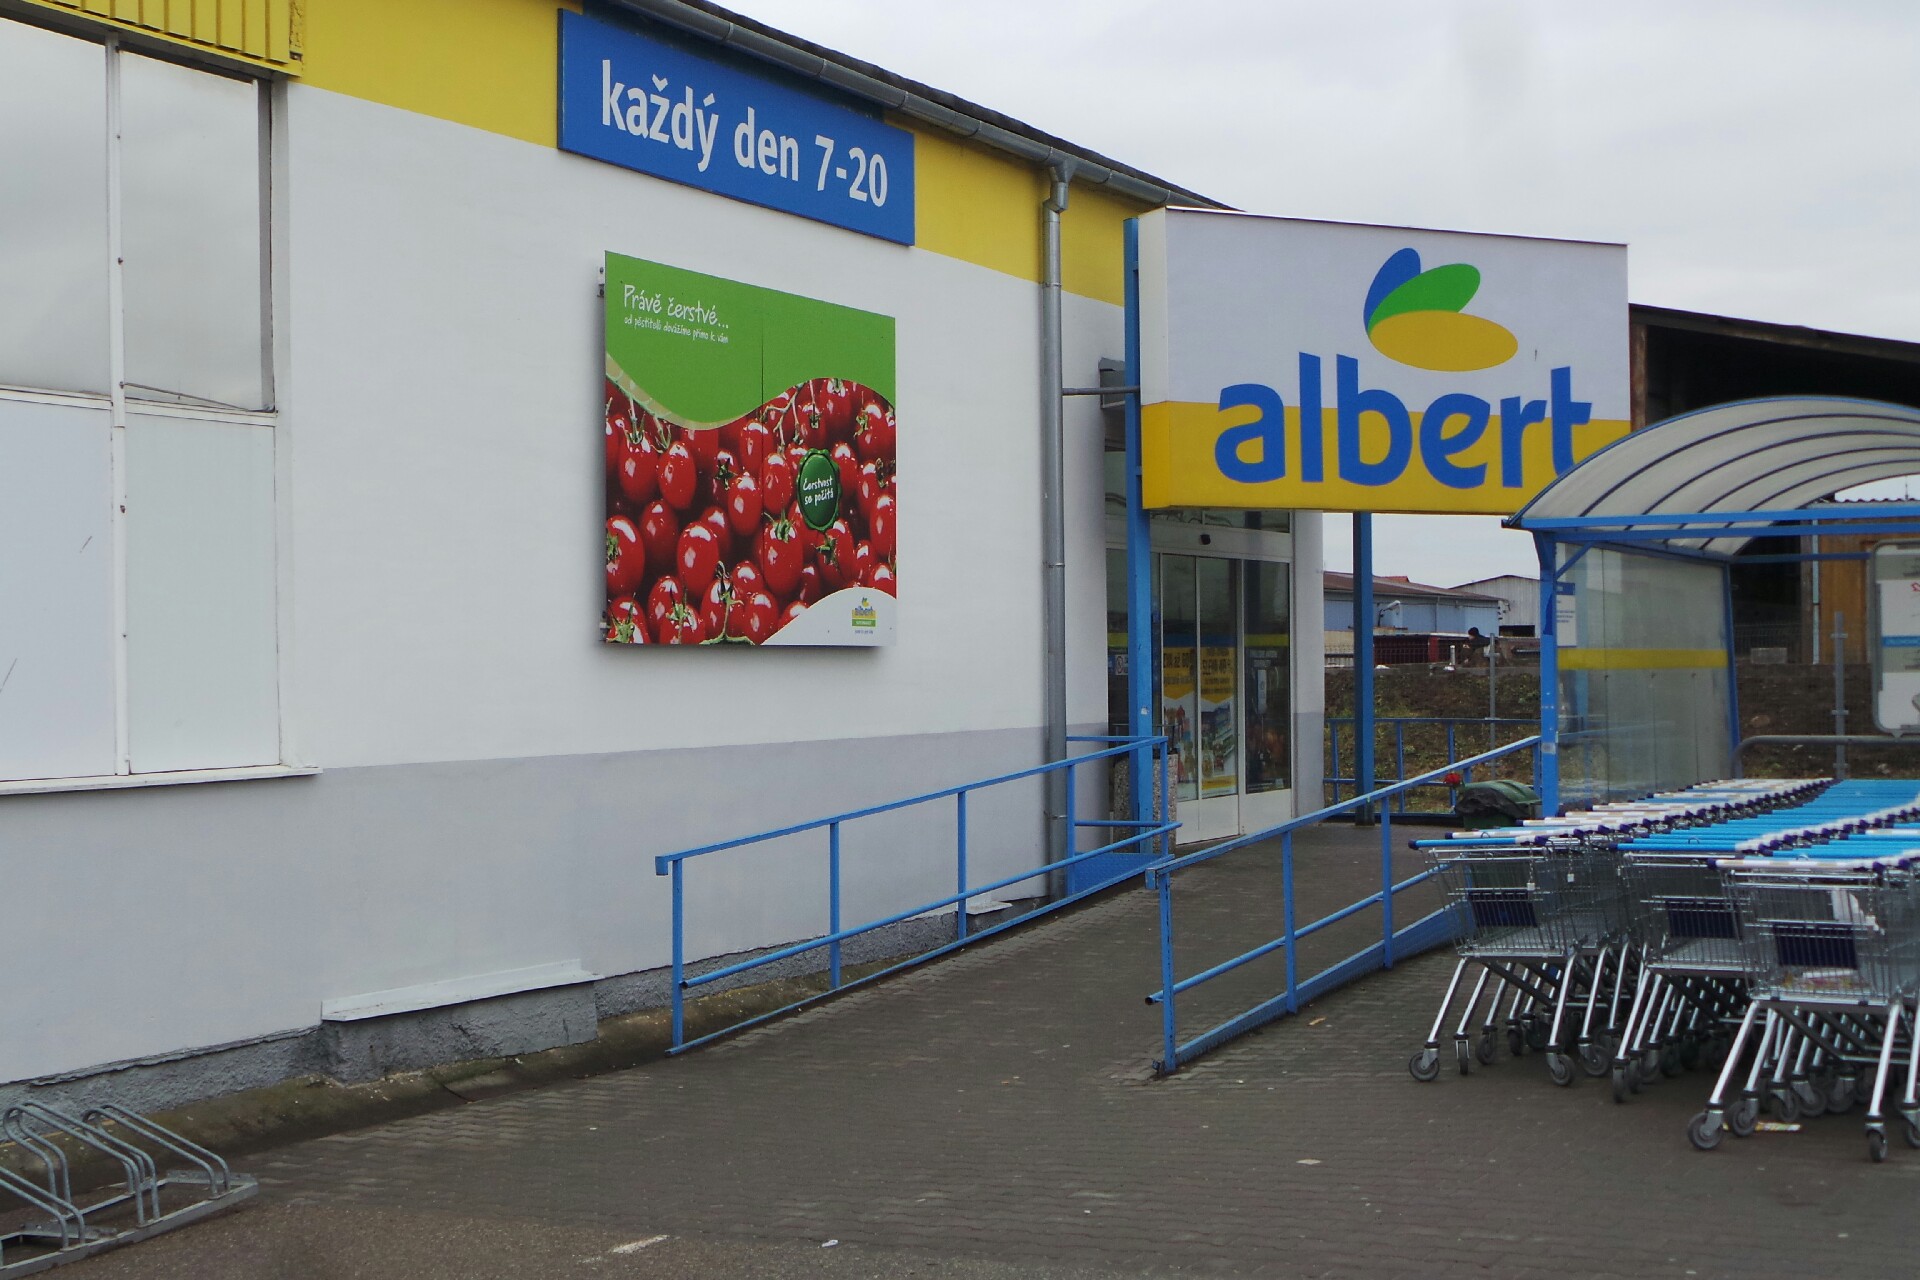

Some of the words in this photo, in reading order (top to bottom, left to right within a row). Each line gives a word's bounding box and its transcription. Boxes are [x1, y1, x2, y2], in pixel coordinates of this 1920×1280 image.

[602, 60, 719, 172] každý
[734, 106, 799, 181] den
[815, 134, 888, 207] 7-20
[624, 284, 662, 314] Právě
[667, 297, 729, 329] čerstvé...
[1214, 351, 1592, 490] albert
